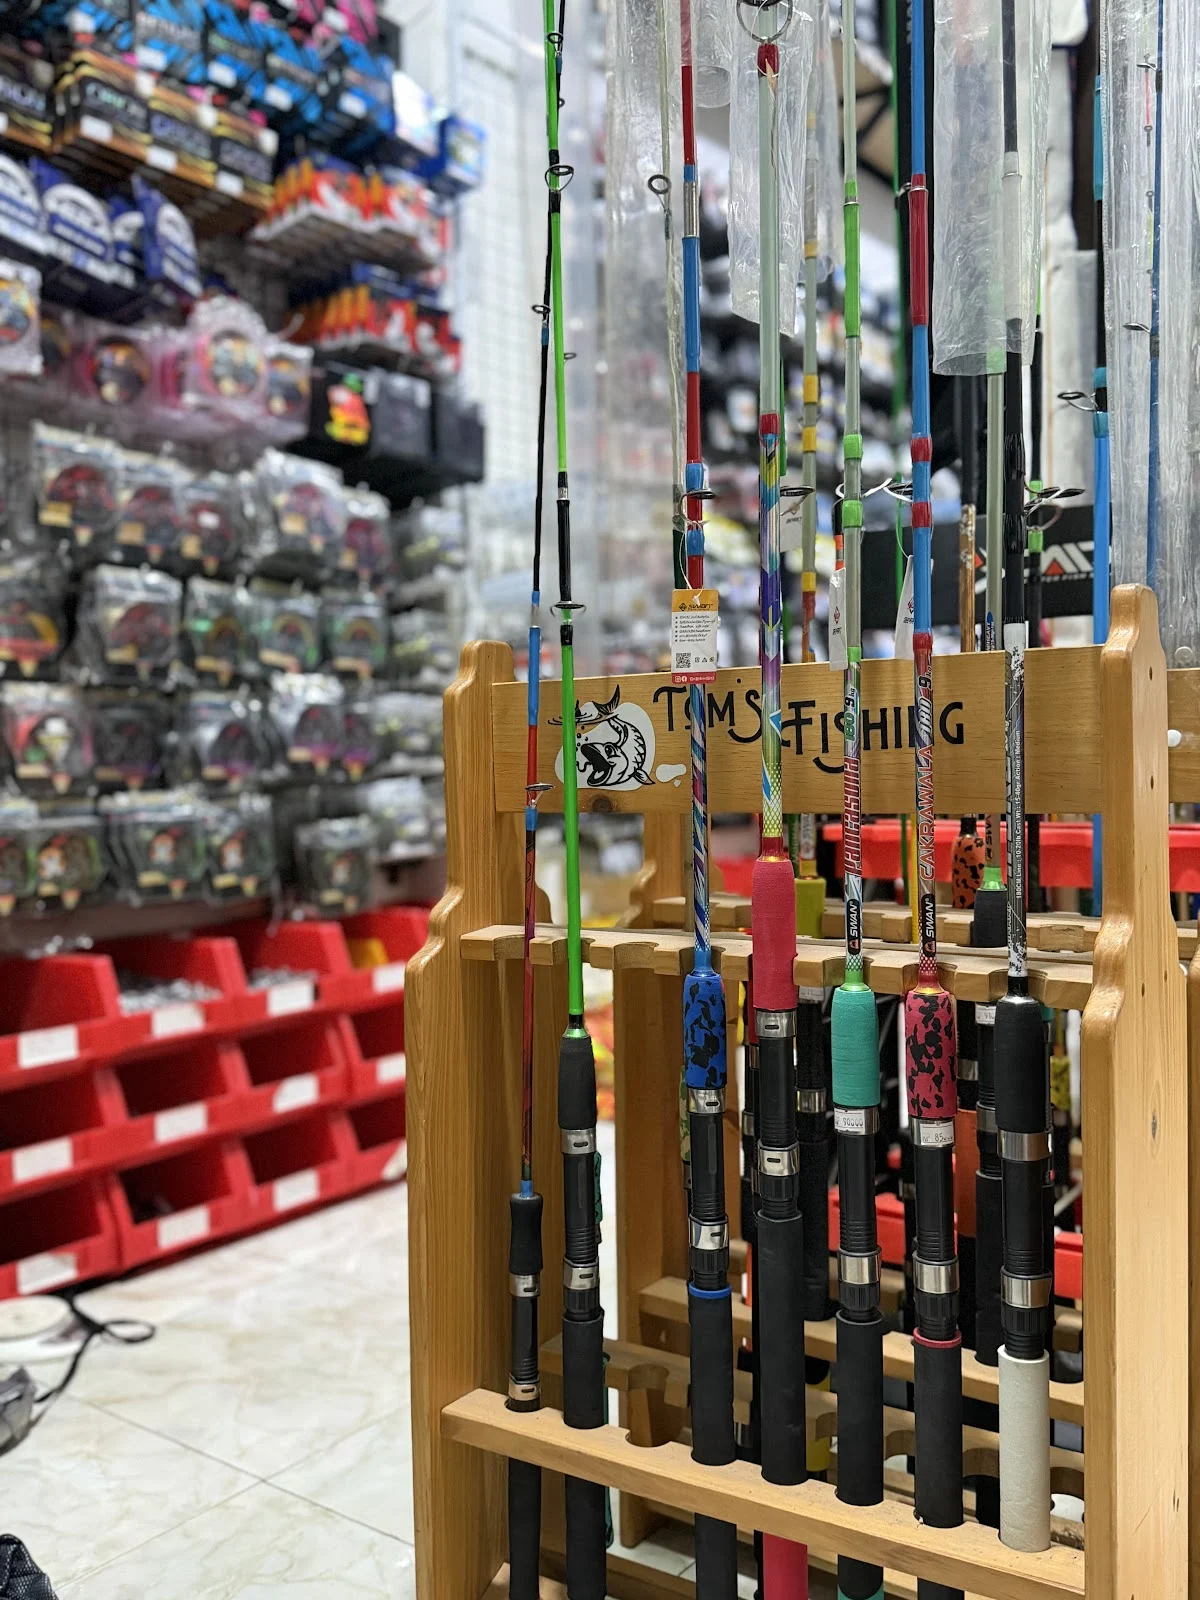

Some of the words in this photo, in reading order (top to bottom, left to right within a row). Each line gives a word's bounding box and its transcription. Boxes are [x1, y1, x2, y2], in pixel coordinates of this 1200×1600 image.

[844, 711, 856, 741] 180
[918, 744, 935, 881] CAKRAWALA
[849, 904, 858, 938] SWAN
[925, 903, 935, 939] SWAN
